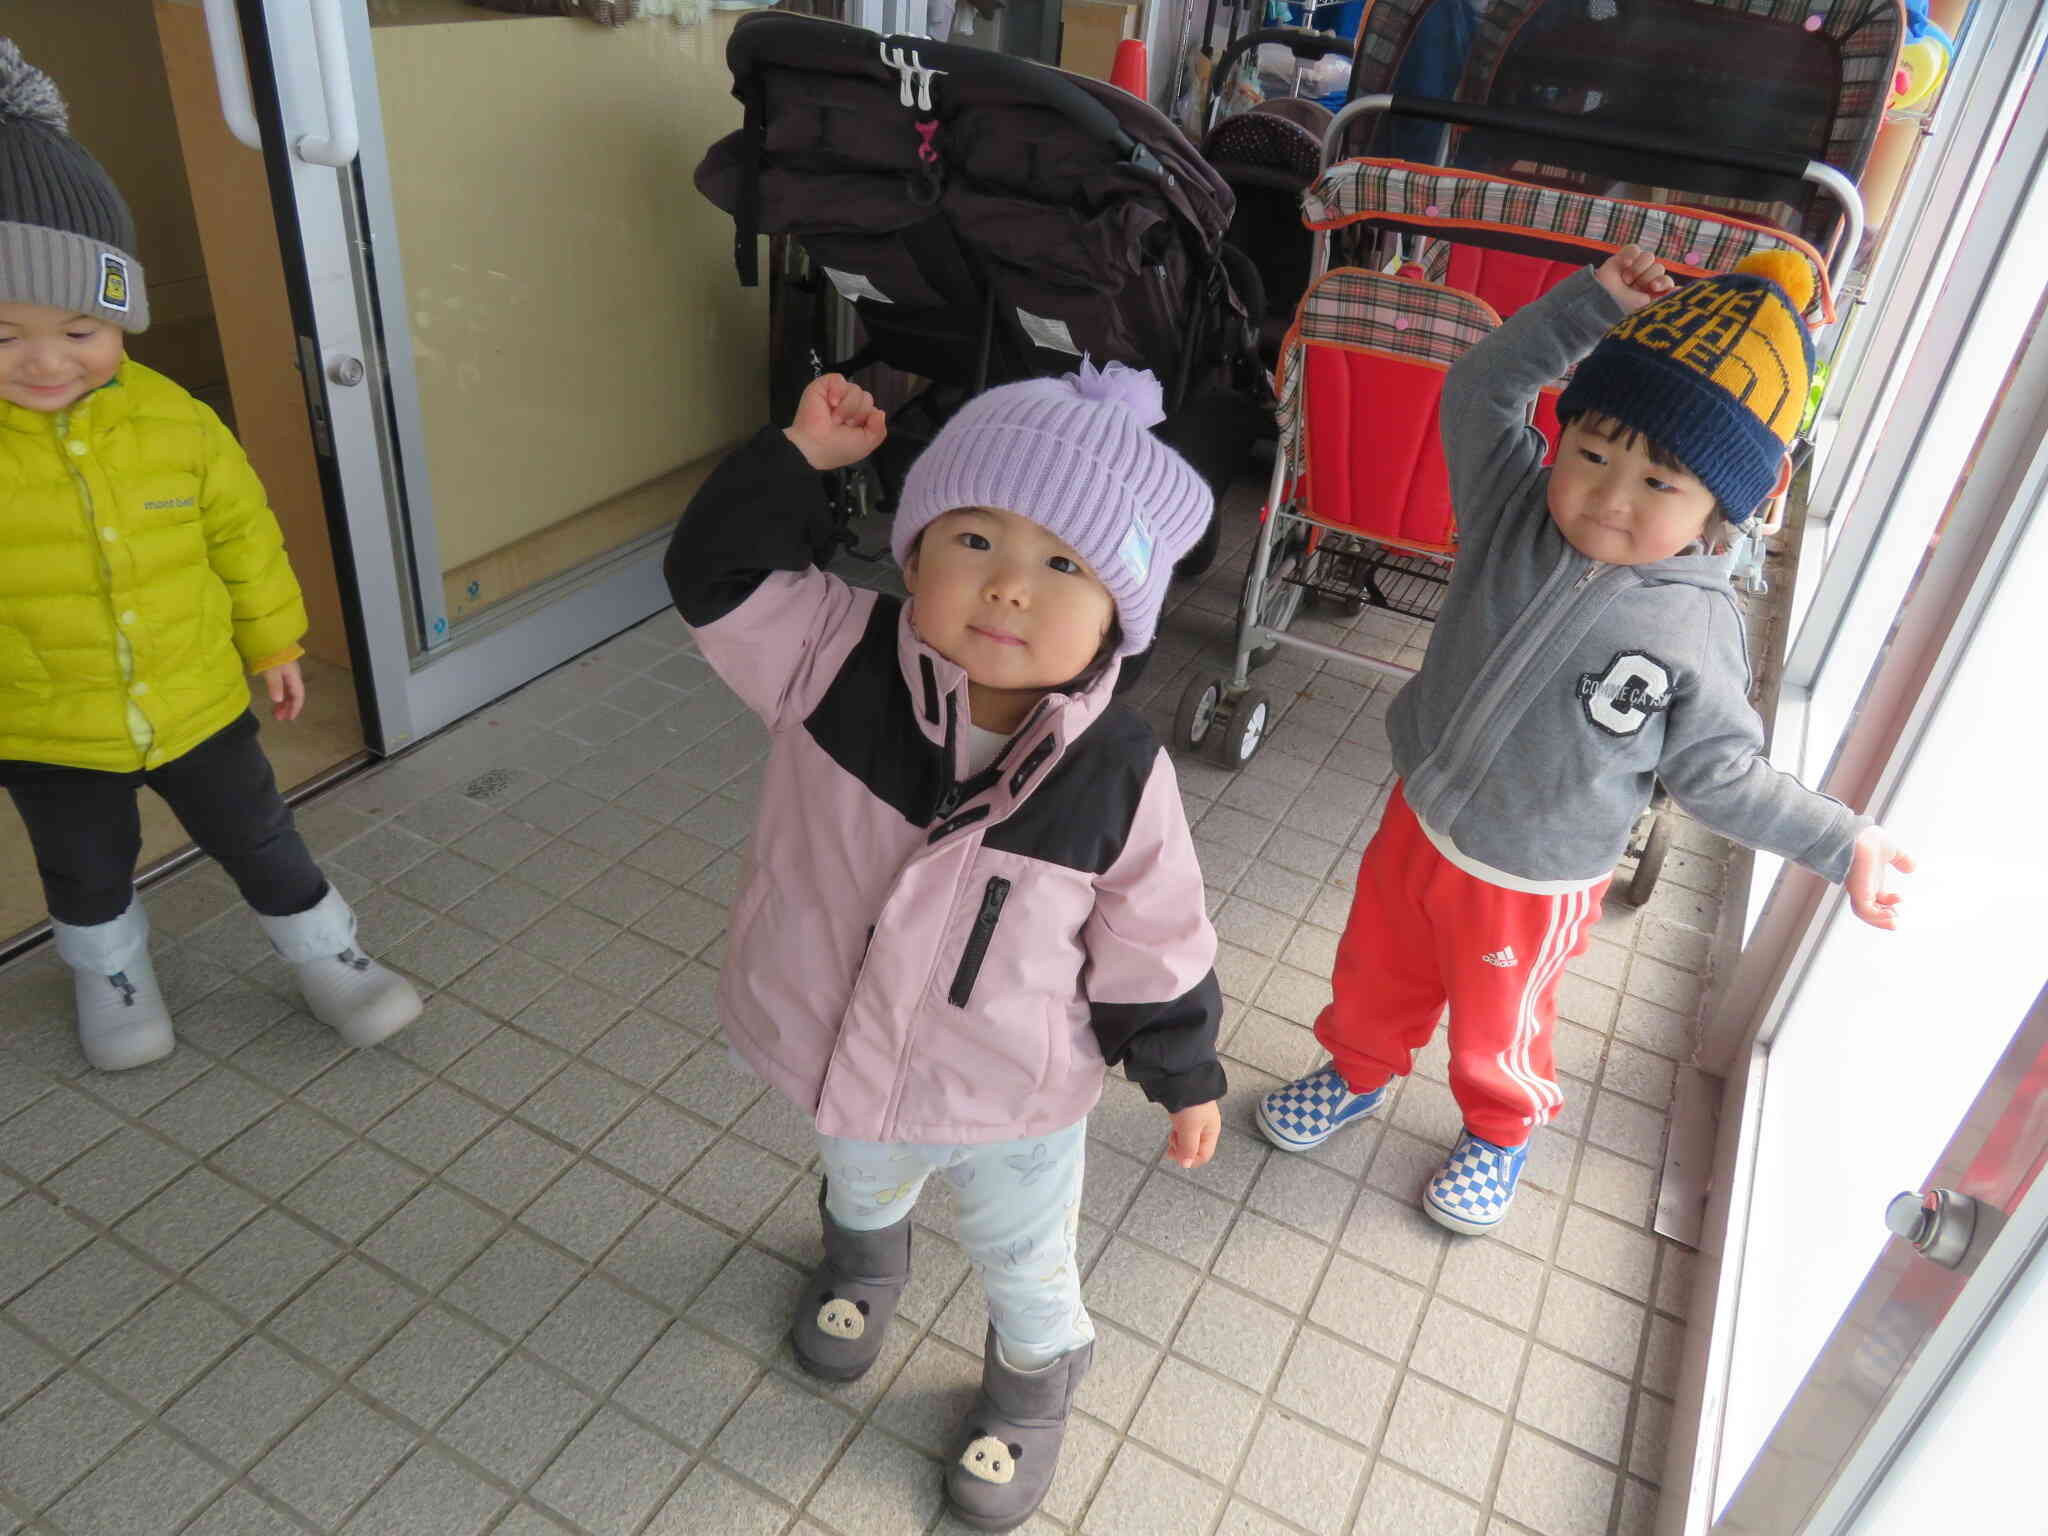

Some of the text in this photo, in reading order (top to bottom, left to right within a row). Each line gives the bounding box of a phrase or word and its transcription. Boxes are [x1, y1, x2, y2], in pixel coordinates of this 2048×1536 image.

[1674, 281, 1764, 321] THE
[1608, 317, 1721, 374] ACE
[1641, 299, 1744, 351] RTH
[1482, 953, 1518, 968] adidas
